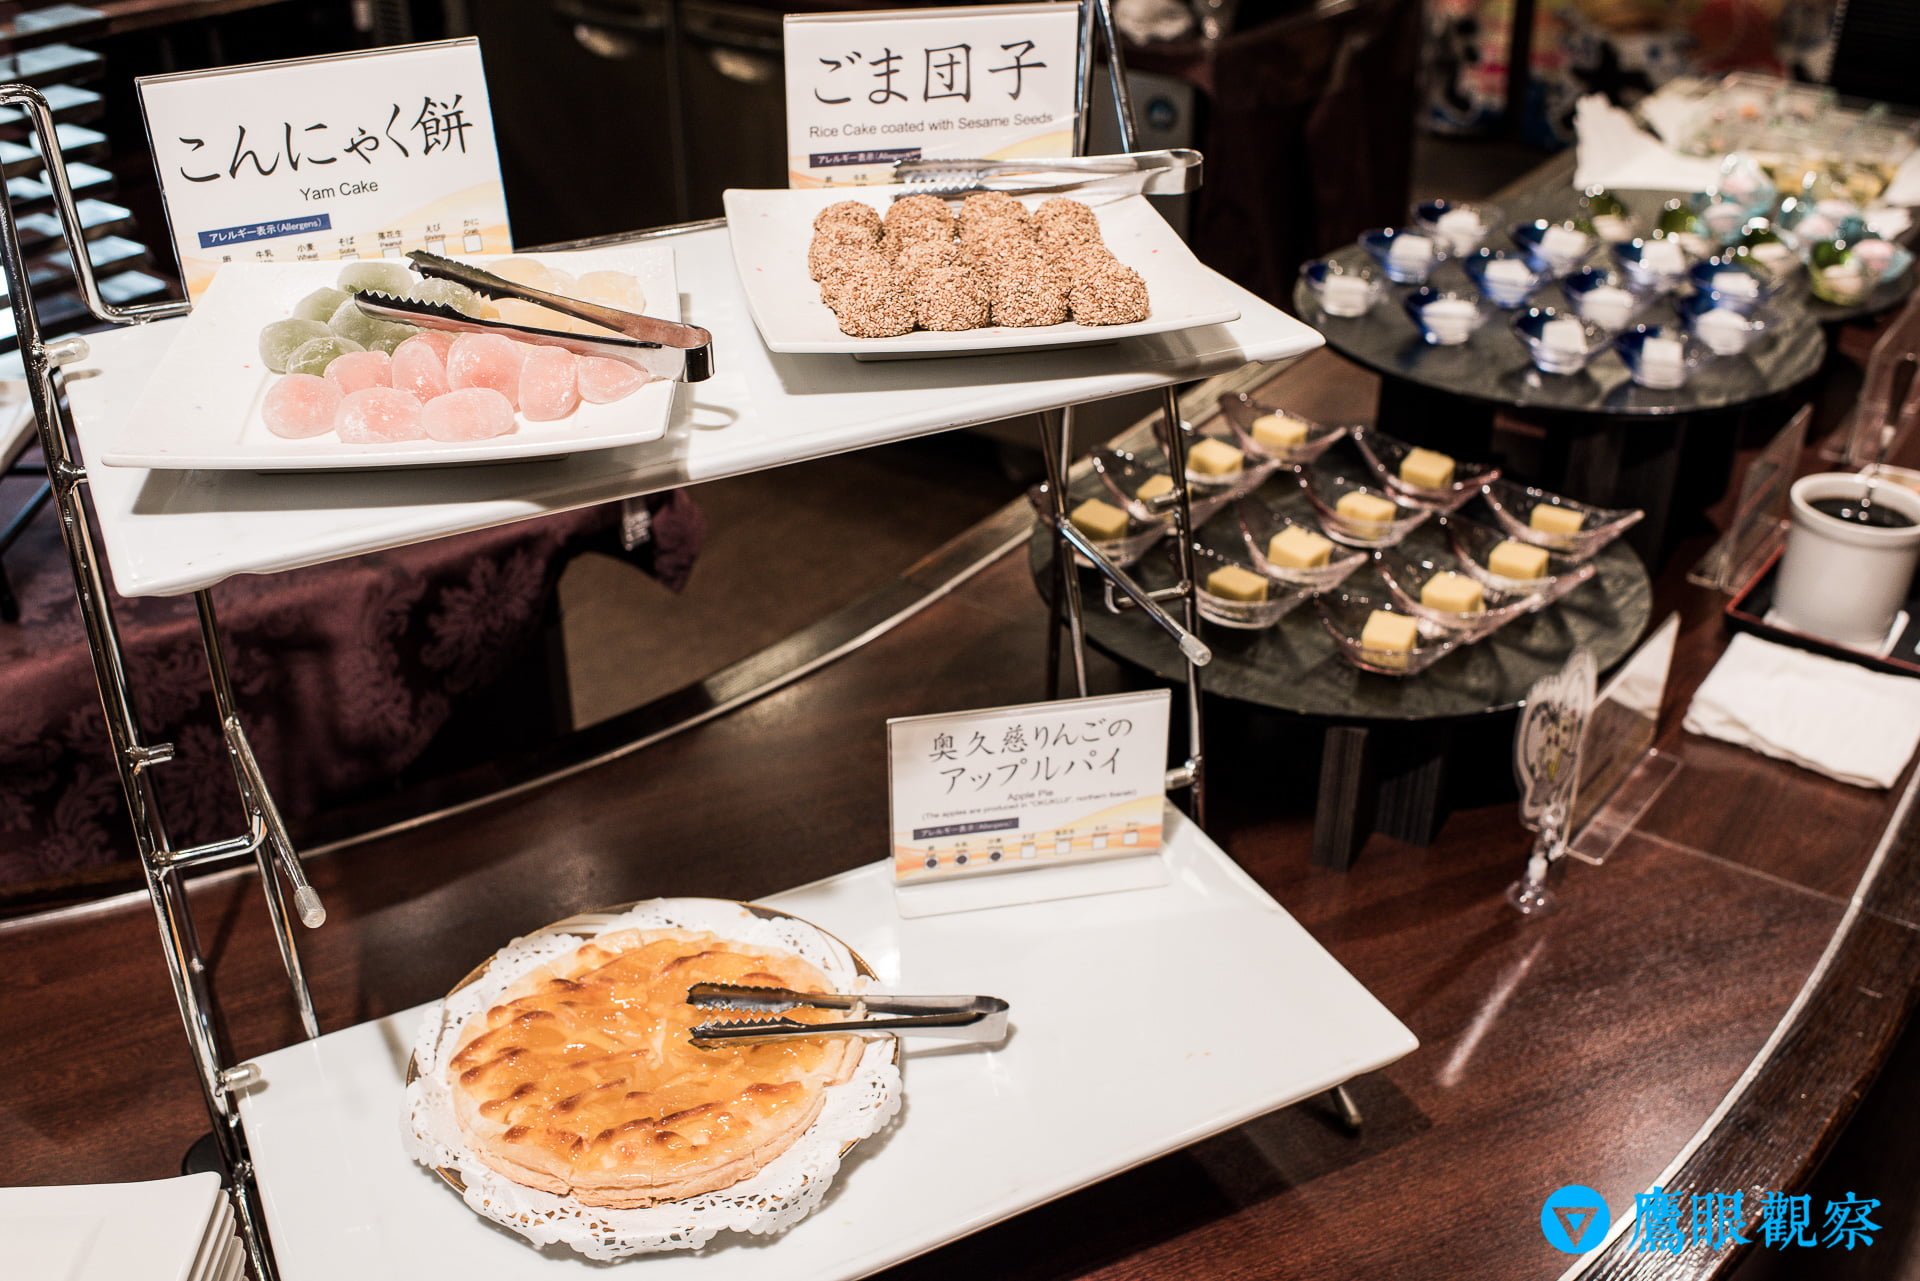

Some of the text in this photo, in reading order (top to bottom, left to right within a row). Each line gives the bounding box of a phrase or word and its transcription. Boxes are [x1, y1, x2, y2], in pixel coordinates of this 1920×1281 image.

[814, 39, 1048, 104] ごま団子
[179, 94, 473, 183] こんにゃく餅
[809, 111, 1053, 137] Rice Cake coated with Sesame Seeds
[300, 180, 379, 201] Yam Cake
[928, 717, 1133, 763] 奥久慈りんごの
[939, 747, 1121, 795] アップルパイ
[1007, 788, 1054, 802] Apple Pie
